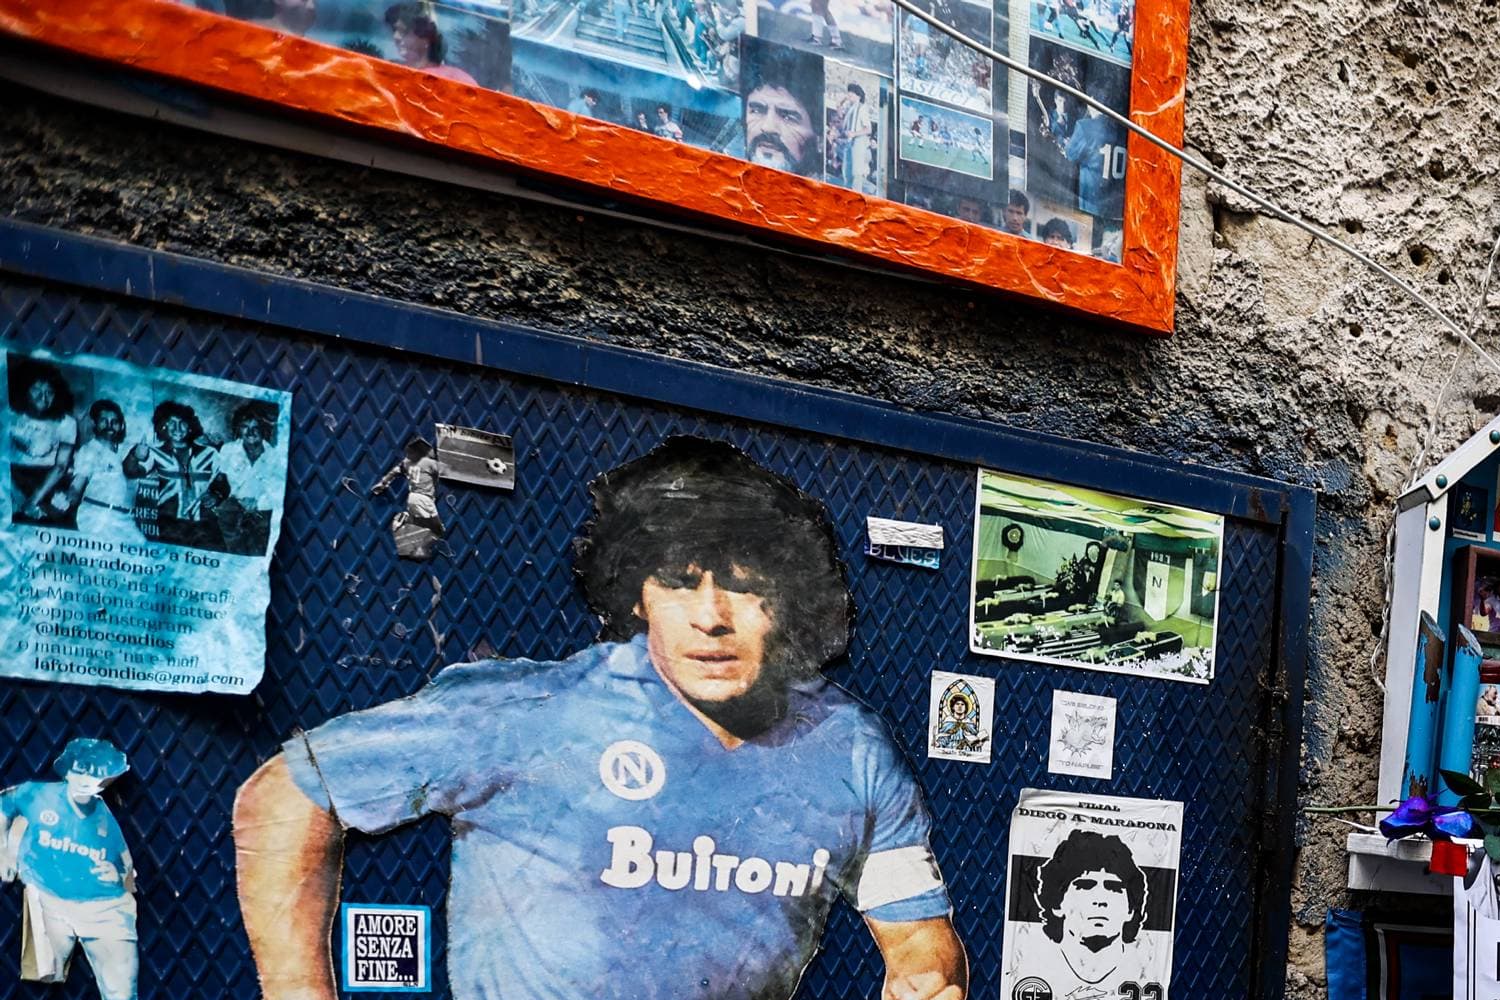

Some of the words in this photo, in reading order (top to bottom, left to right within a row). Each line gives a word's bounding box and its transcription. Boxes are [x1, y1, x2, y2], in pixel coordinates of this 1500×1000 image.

[1100, 143, 1126, 180] 10
[56, 536, 113, 552] nonno
[184, 551, 221, 569] foto
[60, 551, 166, 576] Maradona?
[1152, 576, 1163, 588] N
[35, 622, 175, 650] @lafotocondios
[1078, 801, 1121, 812] FILIAL
[1018, 808, 1067, 821] DIEGO
[1090, 816, 1177, 832] MARADONA
[600, 825, 830, 897] Buitoni
[356, 915, 417, 936] AMORE
[356, 936, 414, 958] SENZA
[357, 960, 414, 981] FINE...
